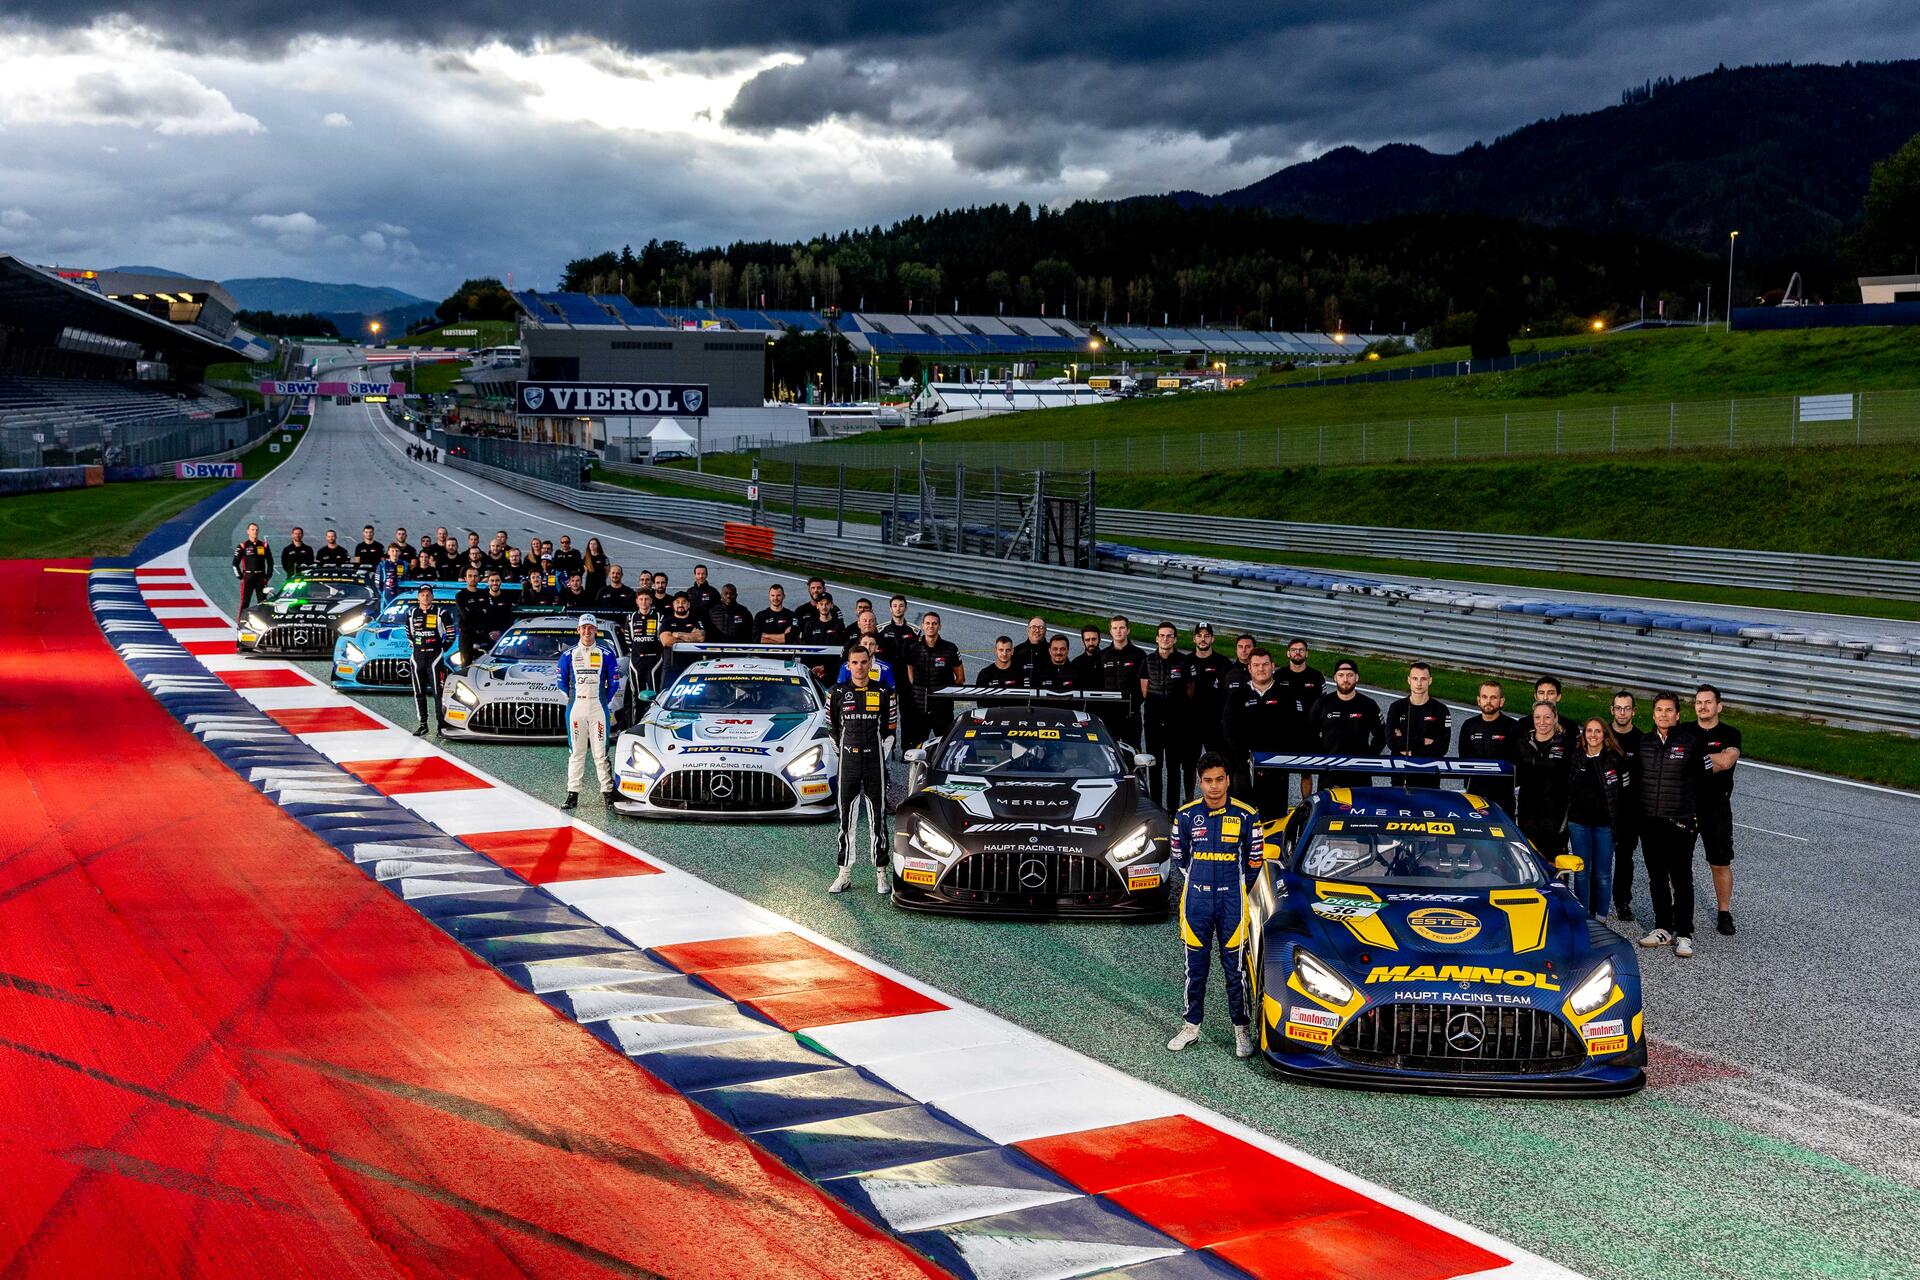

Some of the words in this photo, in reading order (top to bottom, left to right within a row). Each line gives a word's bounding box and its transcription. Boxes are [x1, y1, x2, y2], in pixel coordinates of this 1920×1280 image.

[287, 383, 317, 393] BWT
[360, 383, 389, 393] BWT
[550, 388, 678, 411] VIEROL
[197, 465, 236, 477] BWT
[981, 720, 1083, 728] MERBAG
[686, 746, 763, 754] RAVENOL
[1338, 758, 1502, 771] AMG
[621, 782, 644, 792] PIRELLI
[803, 783, 828, 794] PIRELLI
[997, 798, 1069, 806] MERBAG
[1350, 808, 1482, 819] MERBAG
[1009, 823, 1098, 835] AMG
[1386, 822, 1427, 831] DTM
[1431, 824, 1452, 833] 40
[1193, 851, 1238, 861] MANNOL
[1304, 845, 1343, 872] 36
[906, 872, 933, 882] PIRELLI
[1131, 878, 1158, 888] PIRELLI
[1323, 898, 1382, 908] DEKRA
[1315, 910, 1354, 921] ADAC
[1327, 906, 1359, 914] 36
[1411, 918, 1477, 926] ESTER
[1364, 965, 1561, 991] MANNOL
[1395, 991, 1439, 1001] HAUPT
[1442, 993, 1492, 1003] RACING
[1496, 995, 1531, 1005] TEAM
[1299, 1012, 1339, 1027] motorsport
[1289, 1025, 1328, 1041] PIRELLI
[1590, 1023, 1623, 1036] motorsport
[1591, 1038, 1625, 1052] PIRELLI
